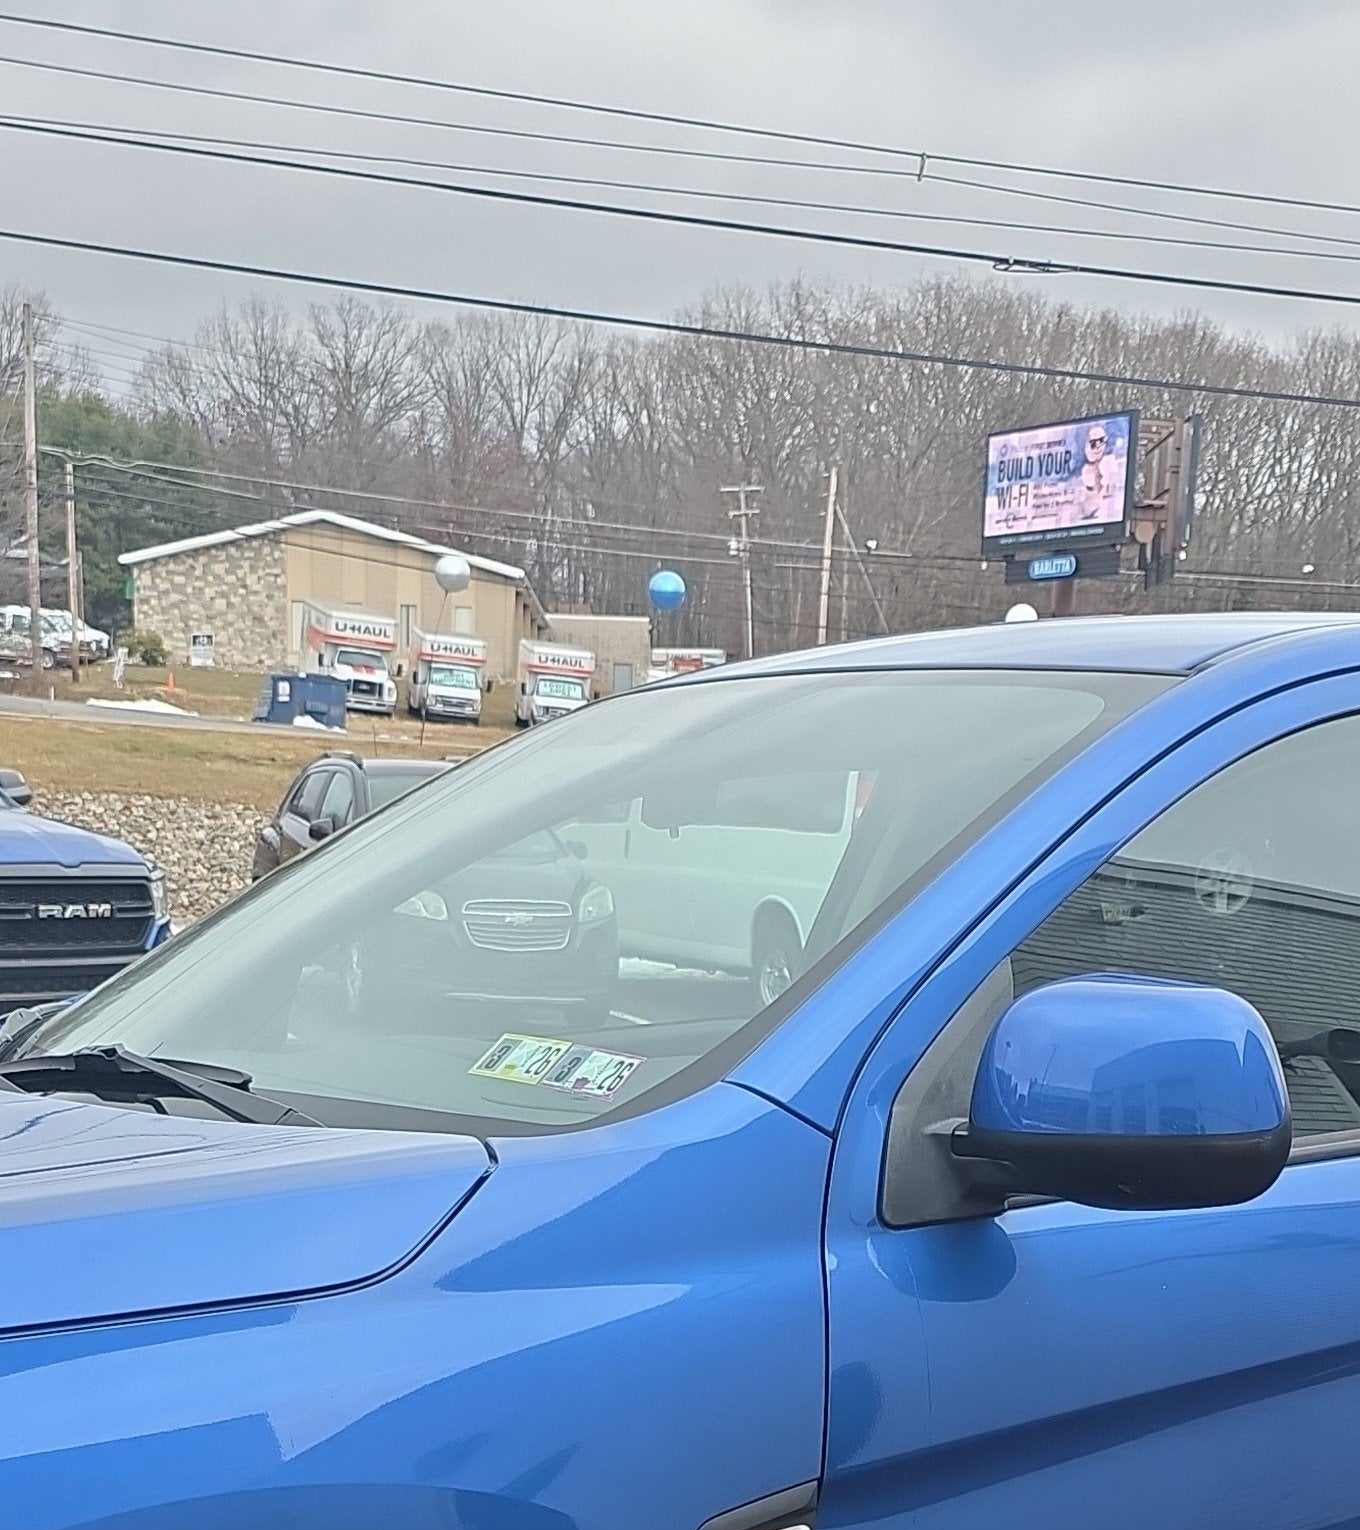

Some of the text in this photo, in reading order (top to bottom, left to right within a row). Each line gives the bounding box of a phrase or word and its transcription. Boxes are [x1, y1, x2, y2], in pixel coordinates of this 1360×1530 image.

[997, 450, 1072, 483] BUILD YOUR
[995, 483, 1029, 510] WI-FI
[335, 621, 390, 639] U-HAUL
[430, 643, 478, 657] U-HAUL
[538, 655, 586, 669] U-HAUL
[39, 903, 111, 919] RAM
[484, 1045, 511, 1070] 3
[524, 1046, 562, 1075] 26
[554, 1056, 582, 1082] 3
[597, 1060, 634, 1092] 26
